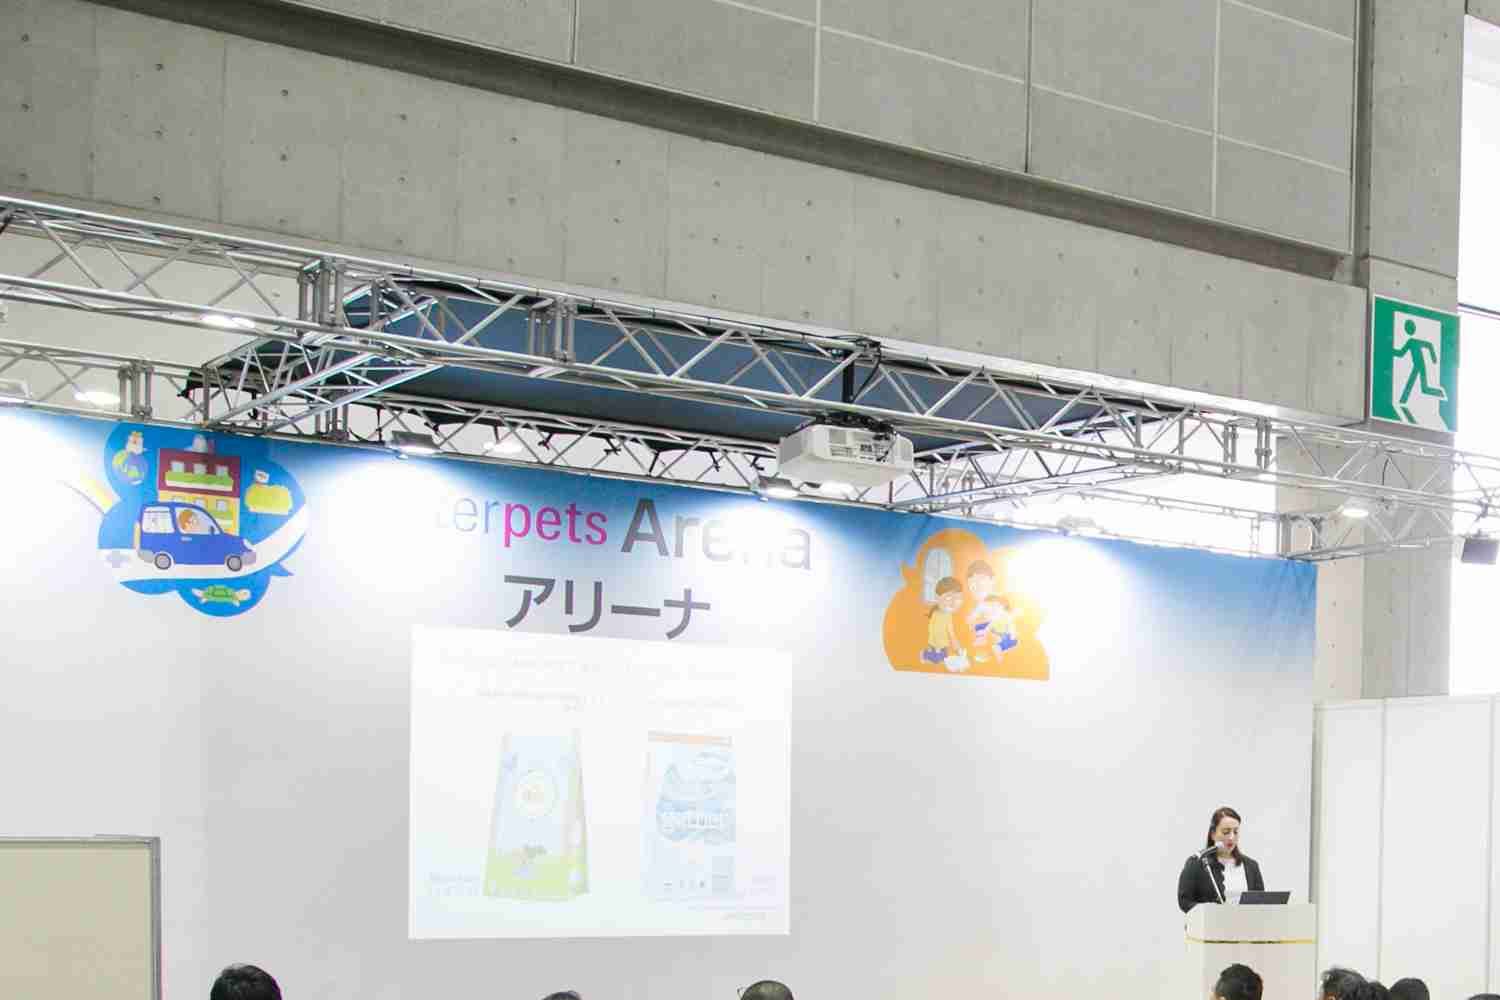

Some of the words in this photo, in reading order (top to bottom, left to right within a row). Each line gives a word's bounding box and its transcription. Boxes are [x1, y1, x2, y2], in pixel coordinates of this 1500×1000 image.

[434, 494, 608, 547] erpets
[620, 497, 812, 570] Area
[503, 574, 712, 641] アリーナ
